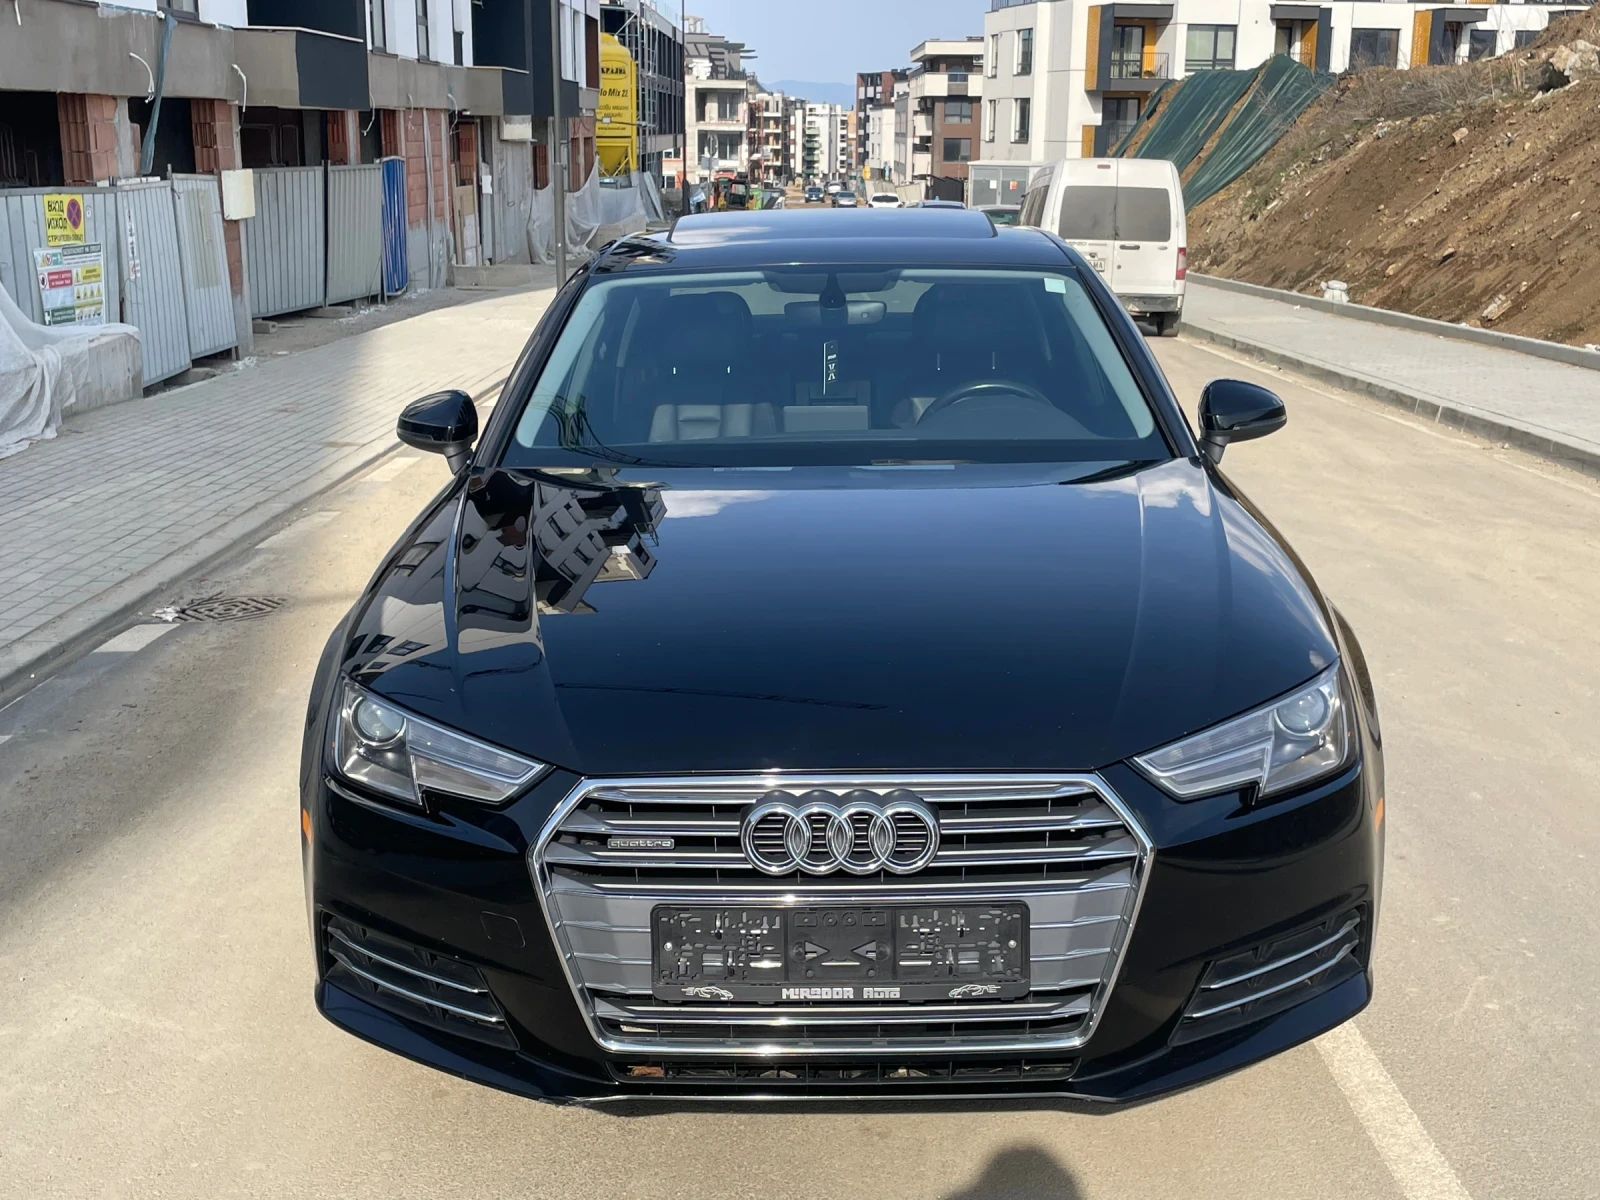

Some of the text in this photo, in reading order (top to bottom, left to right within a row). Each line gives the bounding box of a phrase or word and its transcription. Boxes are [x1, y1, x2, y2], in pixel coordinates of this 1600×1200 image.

[608, 88, 621, 97] Mix
[621, 89, 628, 98] 22
[47, 200, 64, 214] ВХОД
[47, 217, 68, 231] ИЗХОД
[610, 840, 671, 848] quattro
